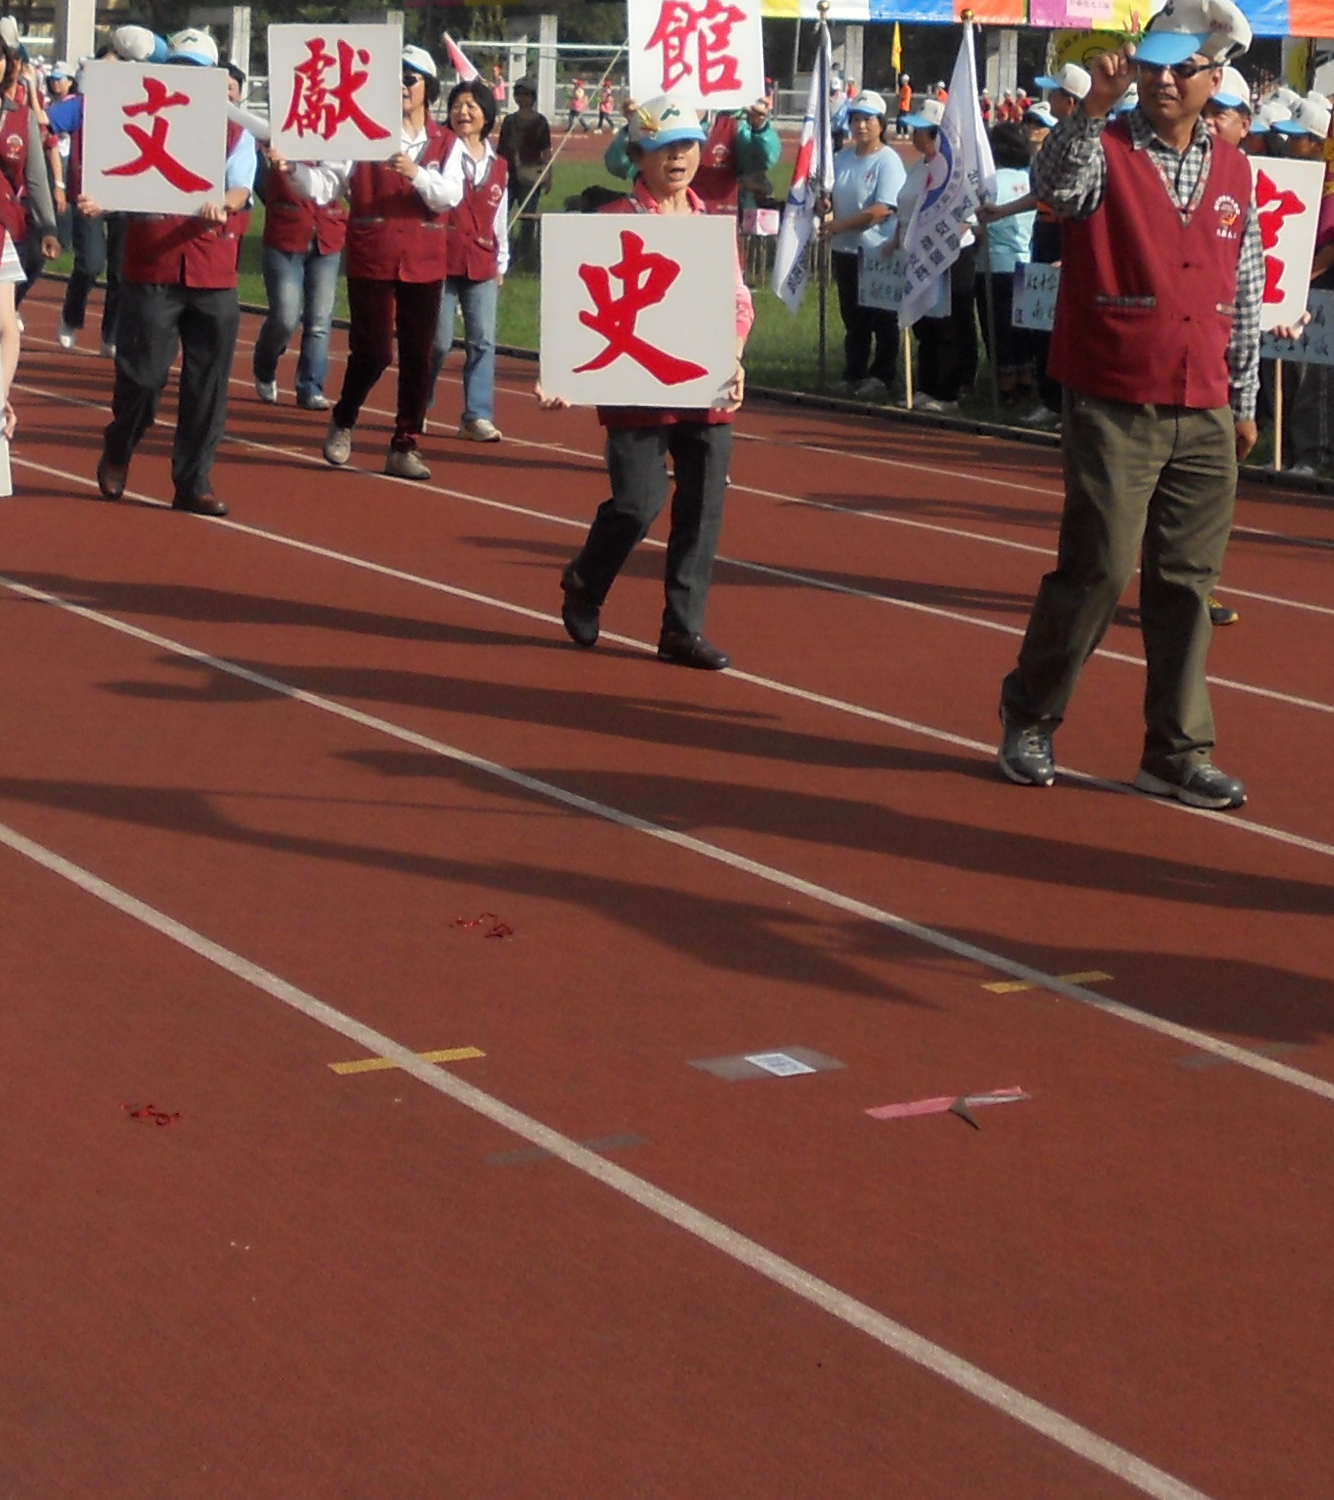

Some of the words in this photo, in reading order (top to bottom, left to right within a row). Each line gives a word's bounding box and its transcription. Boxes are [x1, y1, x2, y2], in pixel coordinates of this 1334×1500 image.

[111, 79, 210, 192] 文
[285, 39, 388, 139] 獻
[579, 231, 707, 385] 史
